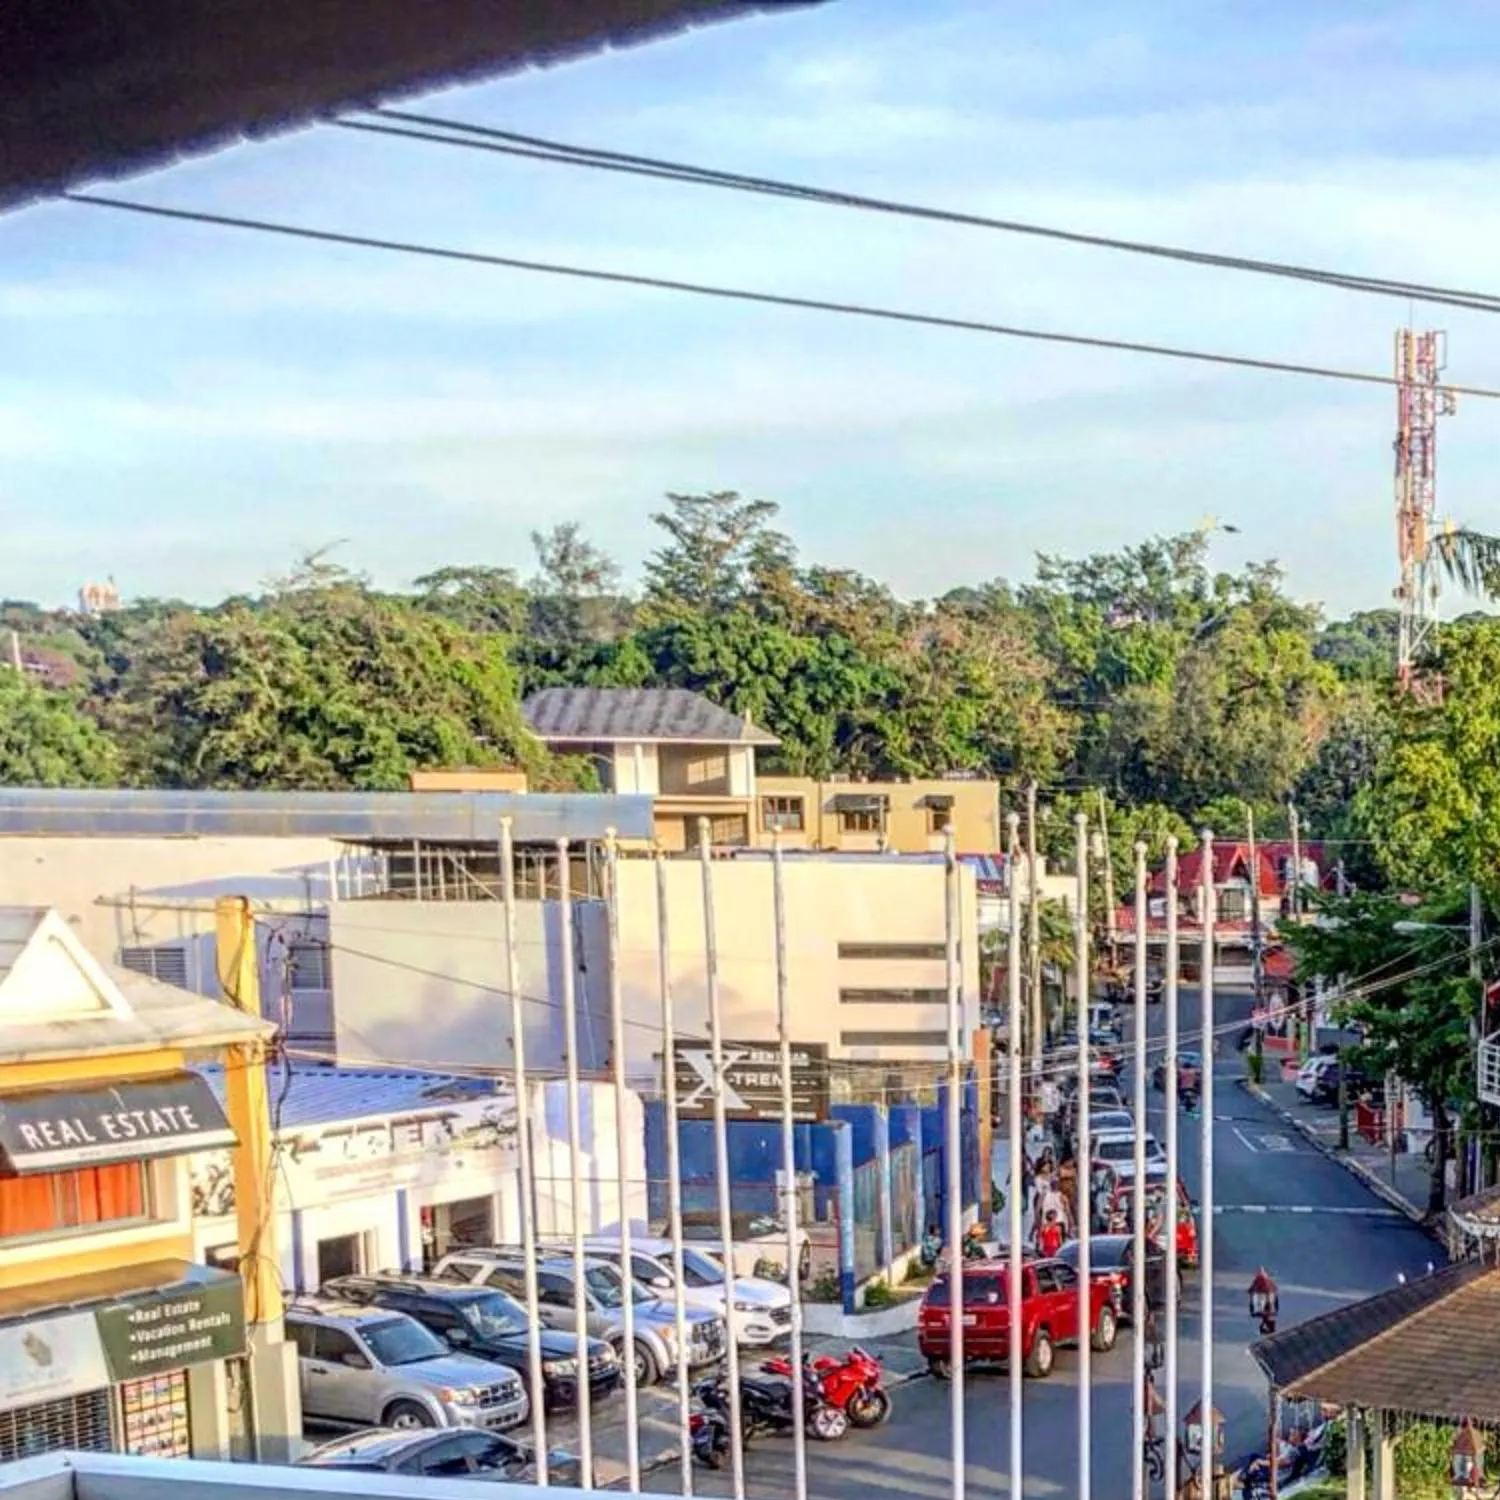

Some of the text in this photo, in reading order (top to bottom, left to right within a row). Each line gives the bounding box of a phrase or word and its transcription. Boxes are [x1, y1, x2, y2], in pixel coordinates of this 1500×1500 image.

[18, 1105, 200, 1149] REAL ESTATE
[135, 1301, 201, 1323] Real Estate
[136, 1311, 231, 1343] Vacation Rentals
[137, 1335, 212, 1363] Management
